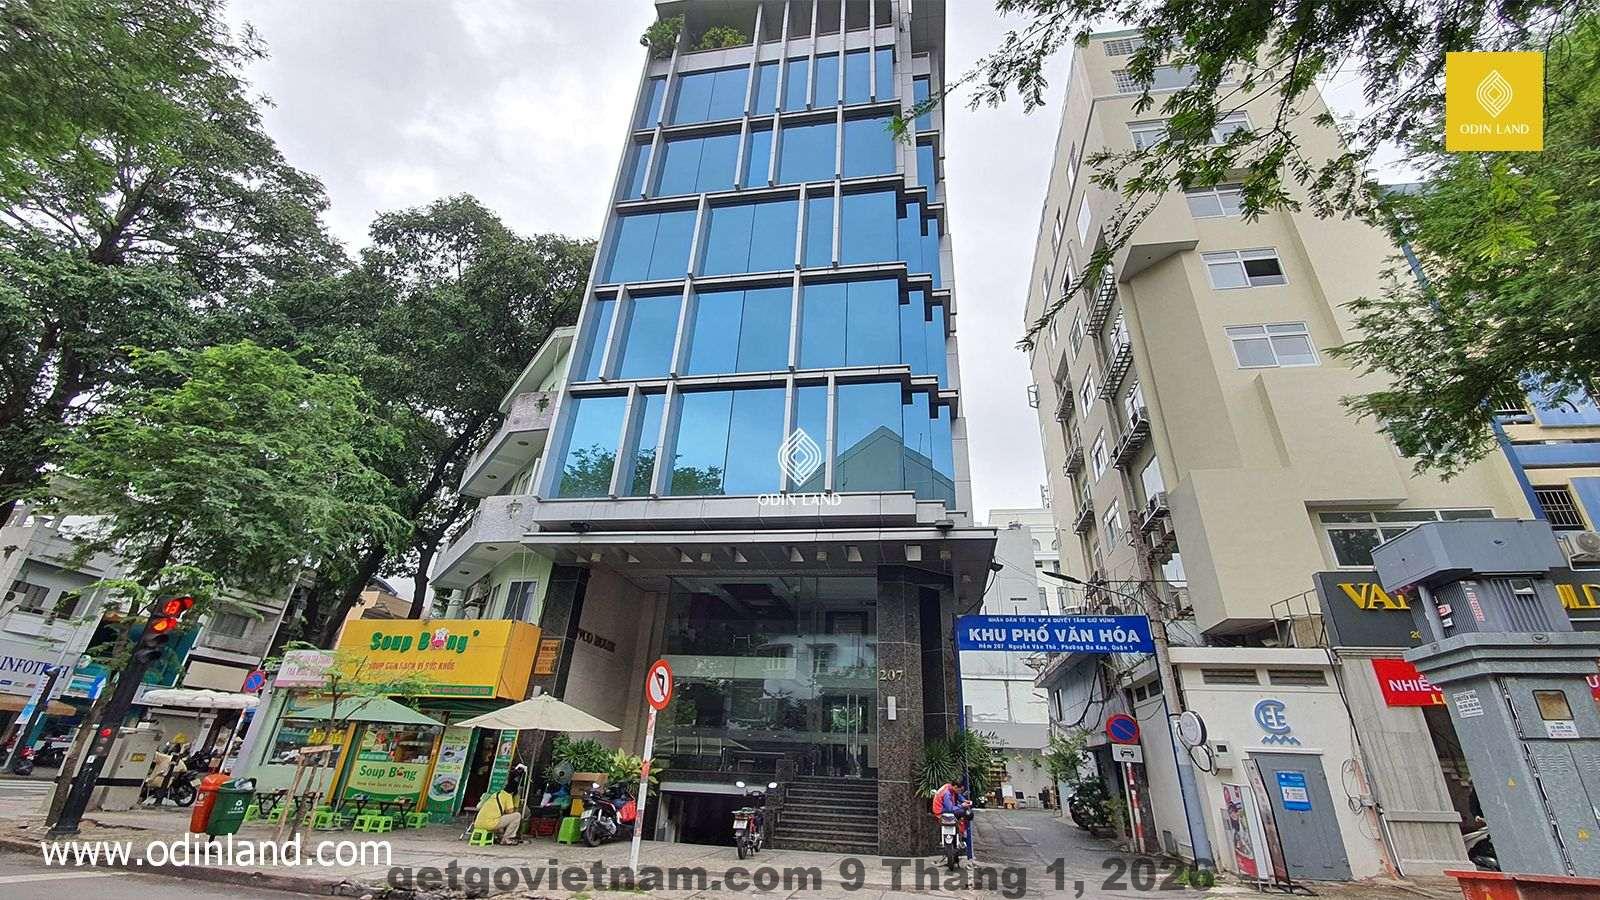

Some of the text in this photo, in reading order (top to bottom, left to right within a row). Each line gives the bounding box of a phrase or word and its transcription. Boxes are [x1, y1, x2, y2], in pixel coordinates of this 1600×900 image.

[370, 631, 413, 653] Soup
[968, 623, 1141, 643] KHU PHỐ VĂN HÓA
[0, 656, 70, 679] INFOTH
[879, 669, 904, 681] 207
[359, 765, 386, 779] Soup
